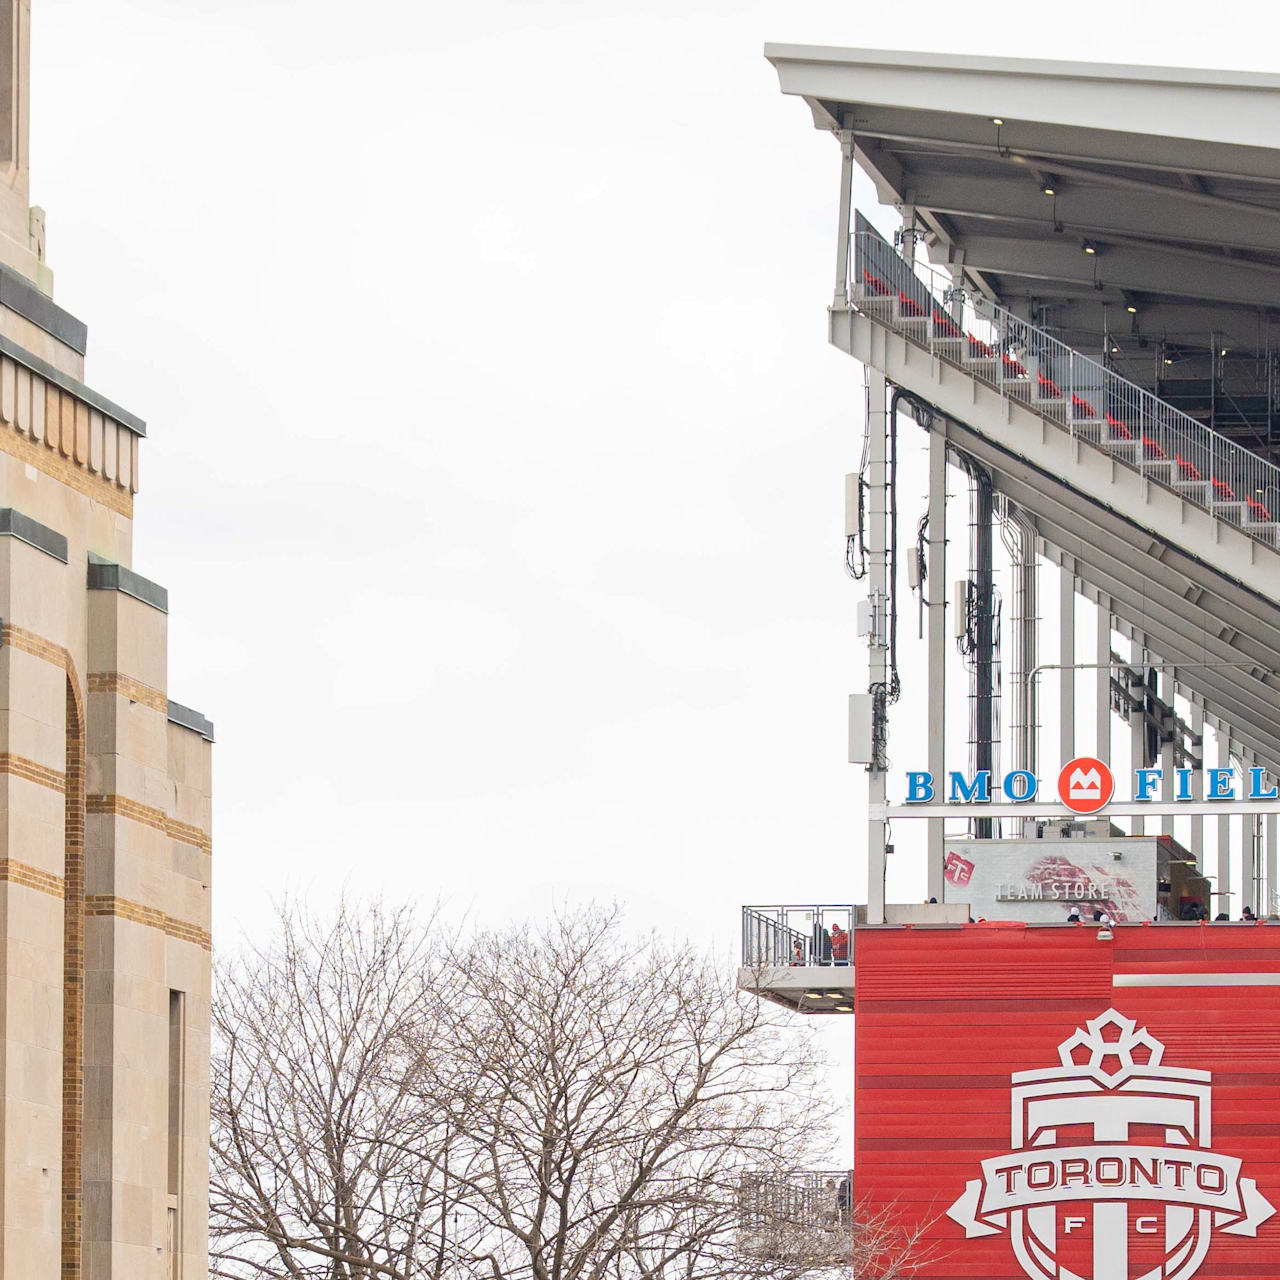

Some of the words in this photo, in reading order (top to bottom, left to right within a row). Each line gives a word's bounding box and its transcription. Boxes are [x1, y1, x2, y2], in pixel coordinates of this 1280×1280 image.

[906, 770, 1038, 803] BMO
[995, 884, 1043, 900] TEAM
[1050, 882, 1110, 900] STORE
[995, 1157, 1228, 1197] TORONTO
